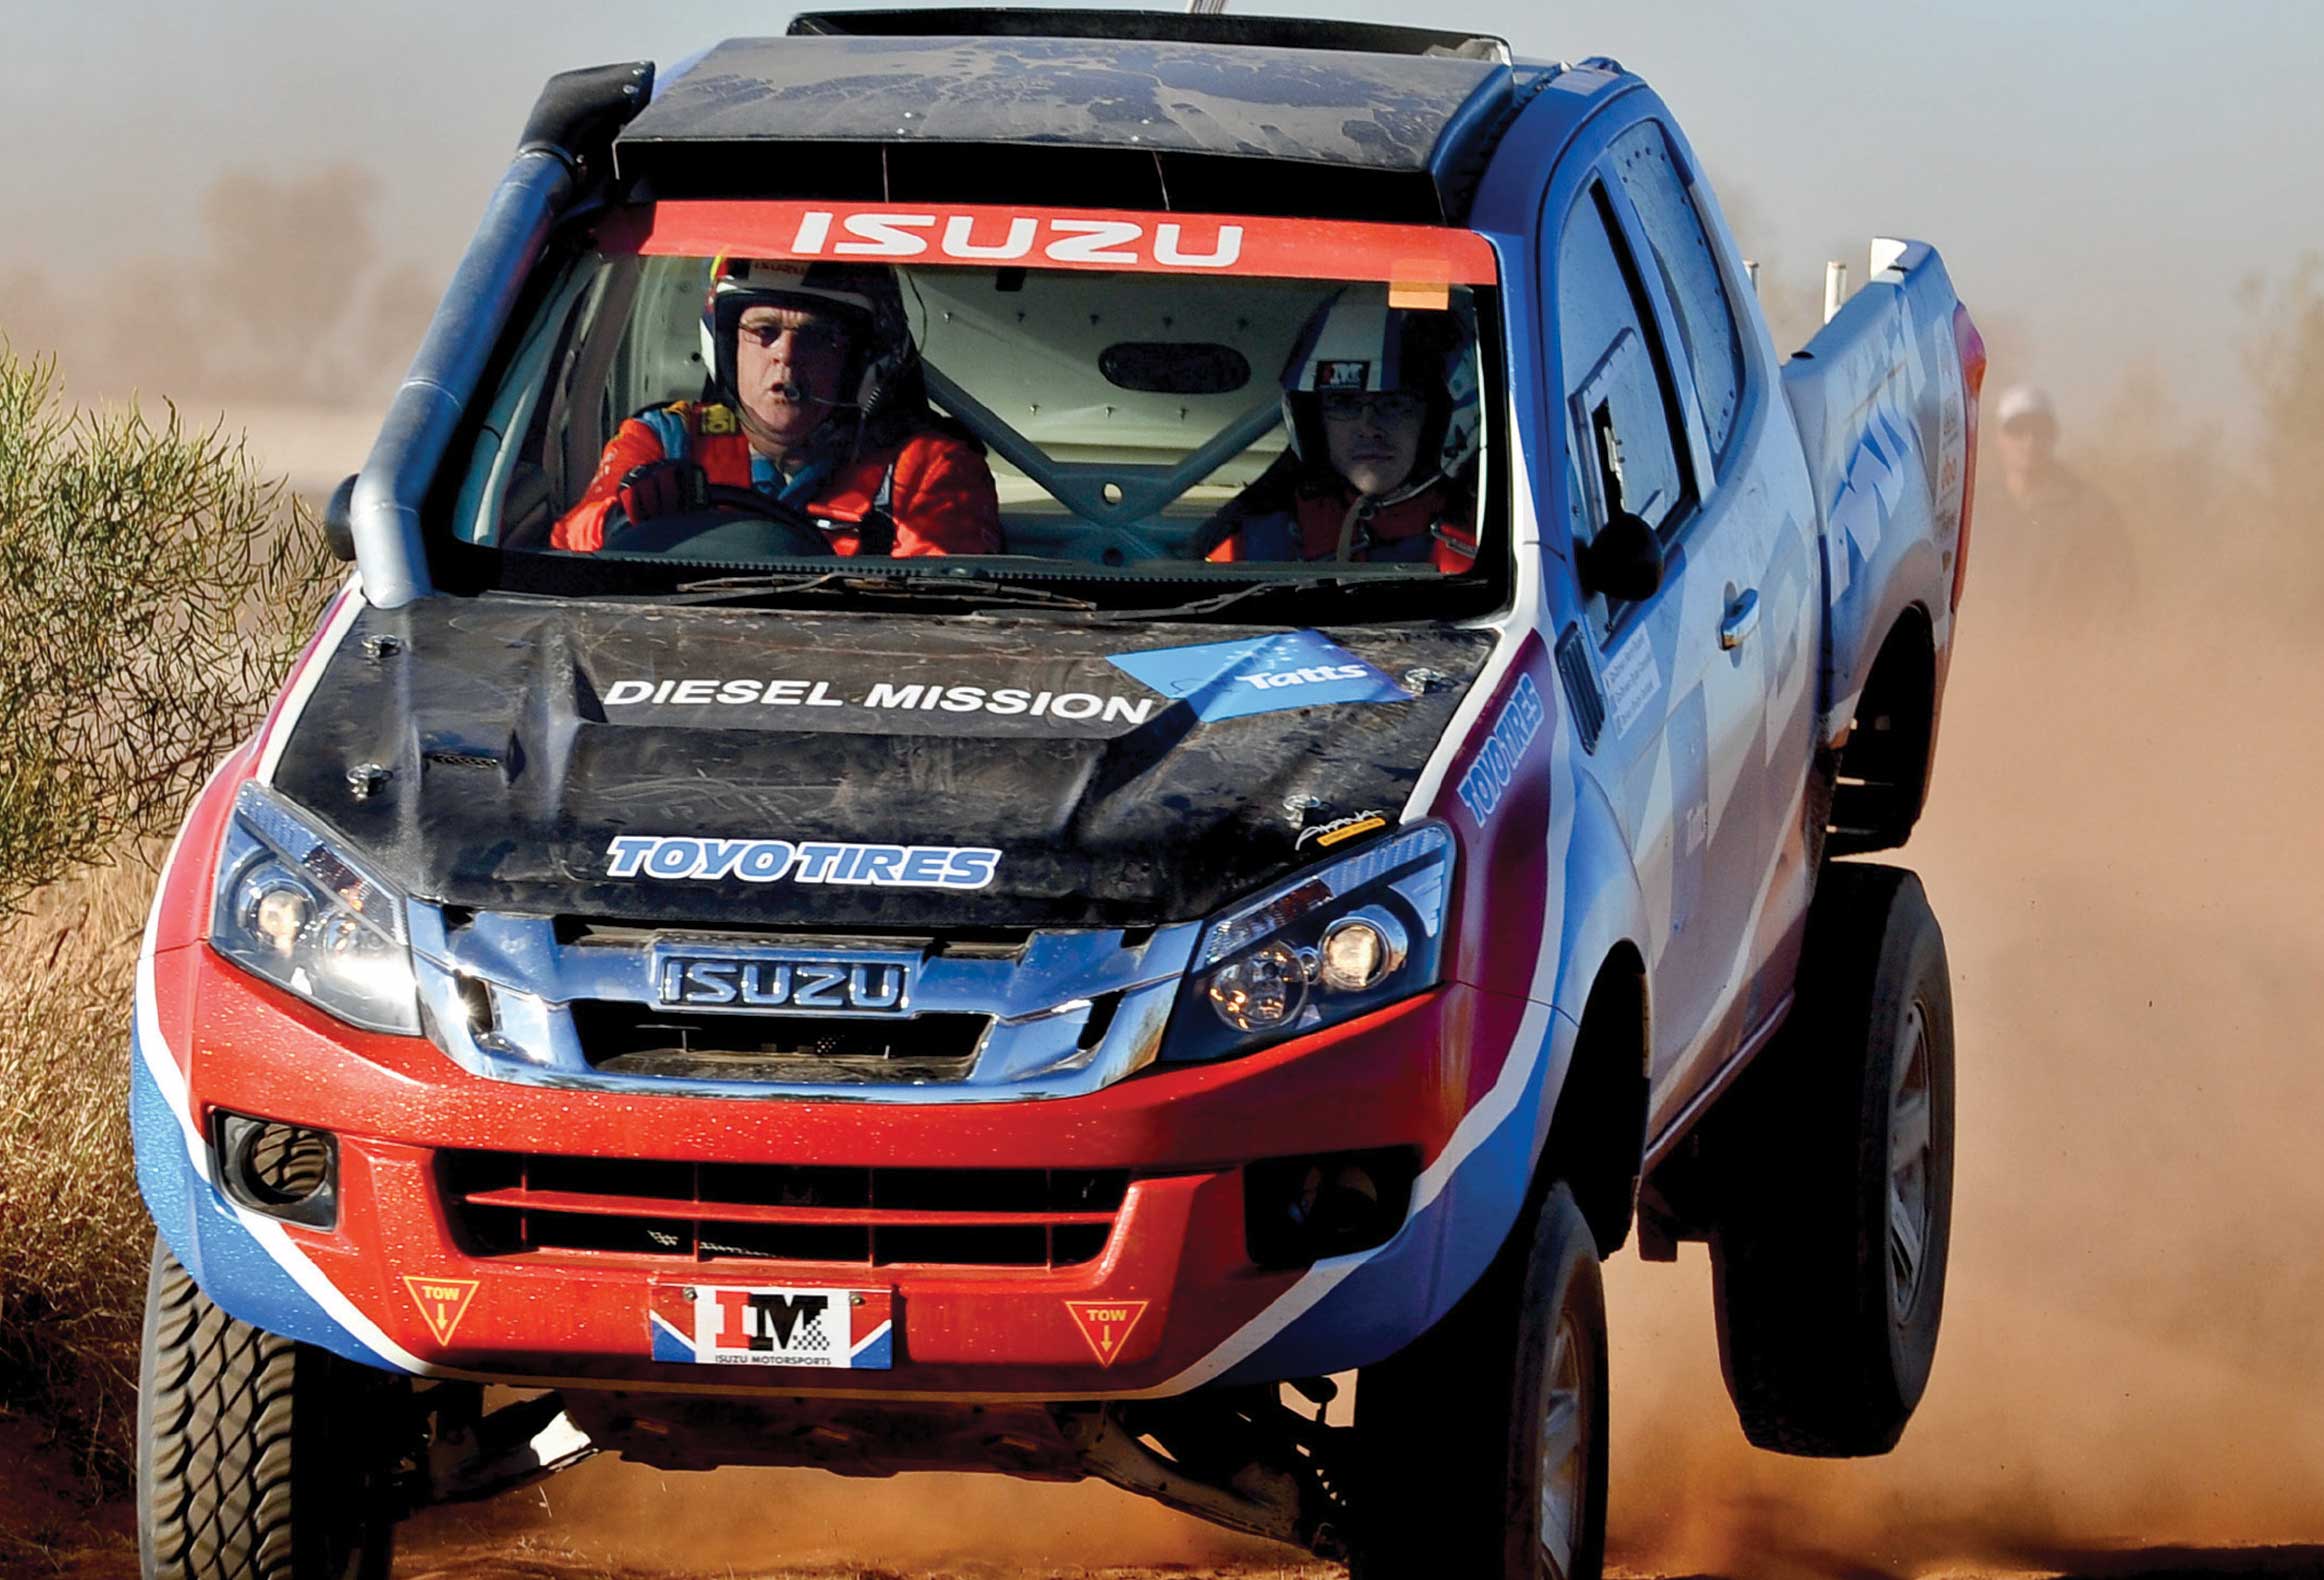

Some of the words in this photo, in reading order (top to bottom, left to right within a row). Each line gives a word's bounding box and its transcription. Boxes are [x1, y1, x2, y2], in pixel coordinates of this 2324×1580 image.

[791, 211, 1243, 267] ISUZU
[1234, 664, 1369, 690] Tatts
[603, 679, 845, 706] DIESEL
[864, 682, 1153, 725] MISSION
[666, 962, 900, 1007] ISUZU
[421, 1286, 460, 1301] TOW
[1086, 1309, 1128, 1322] TOW
[715, 1354, 748, 1364] ISUZU
[751, 1355, 831, 1366] MOTORSPORTS
